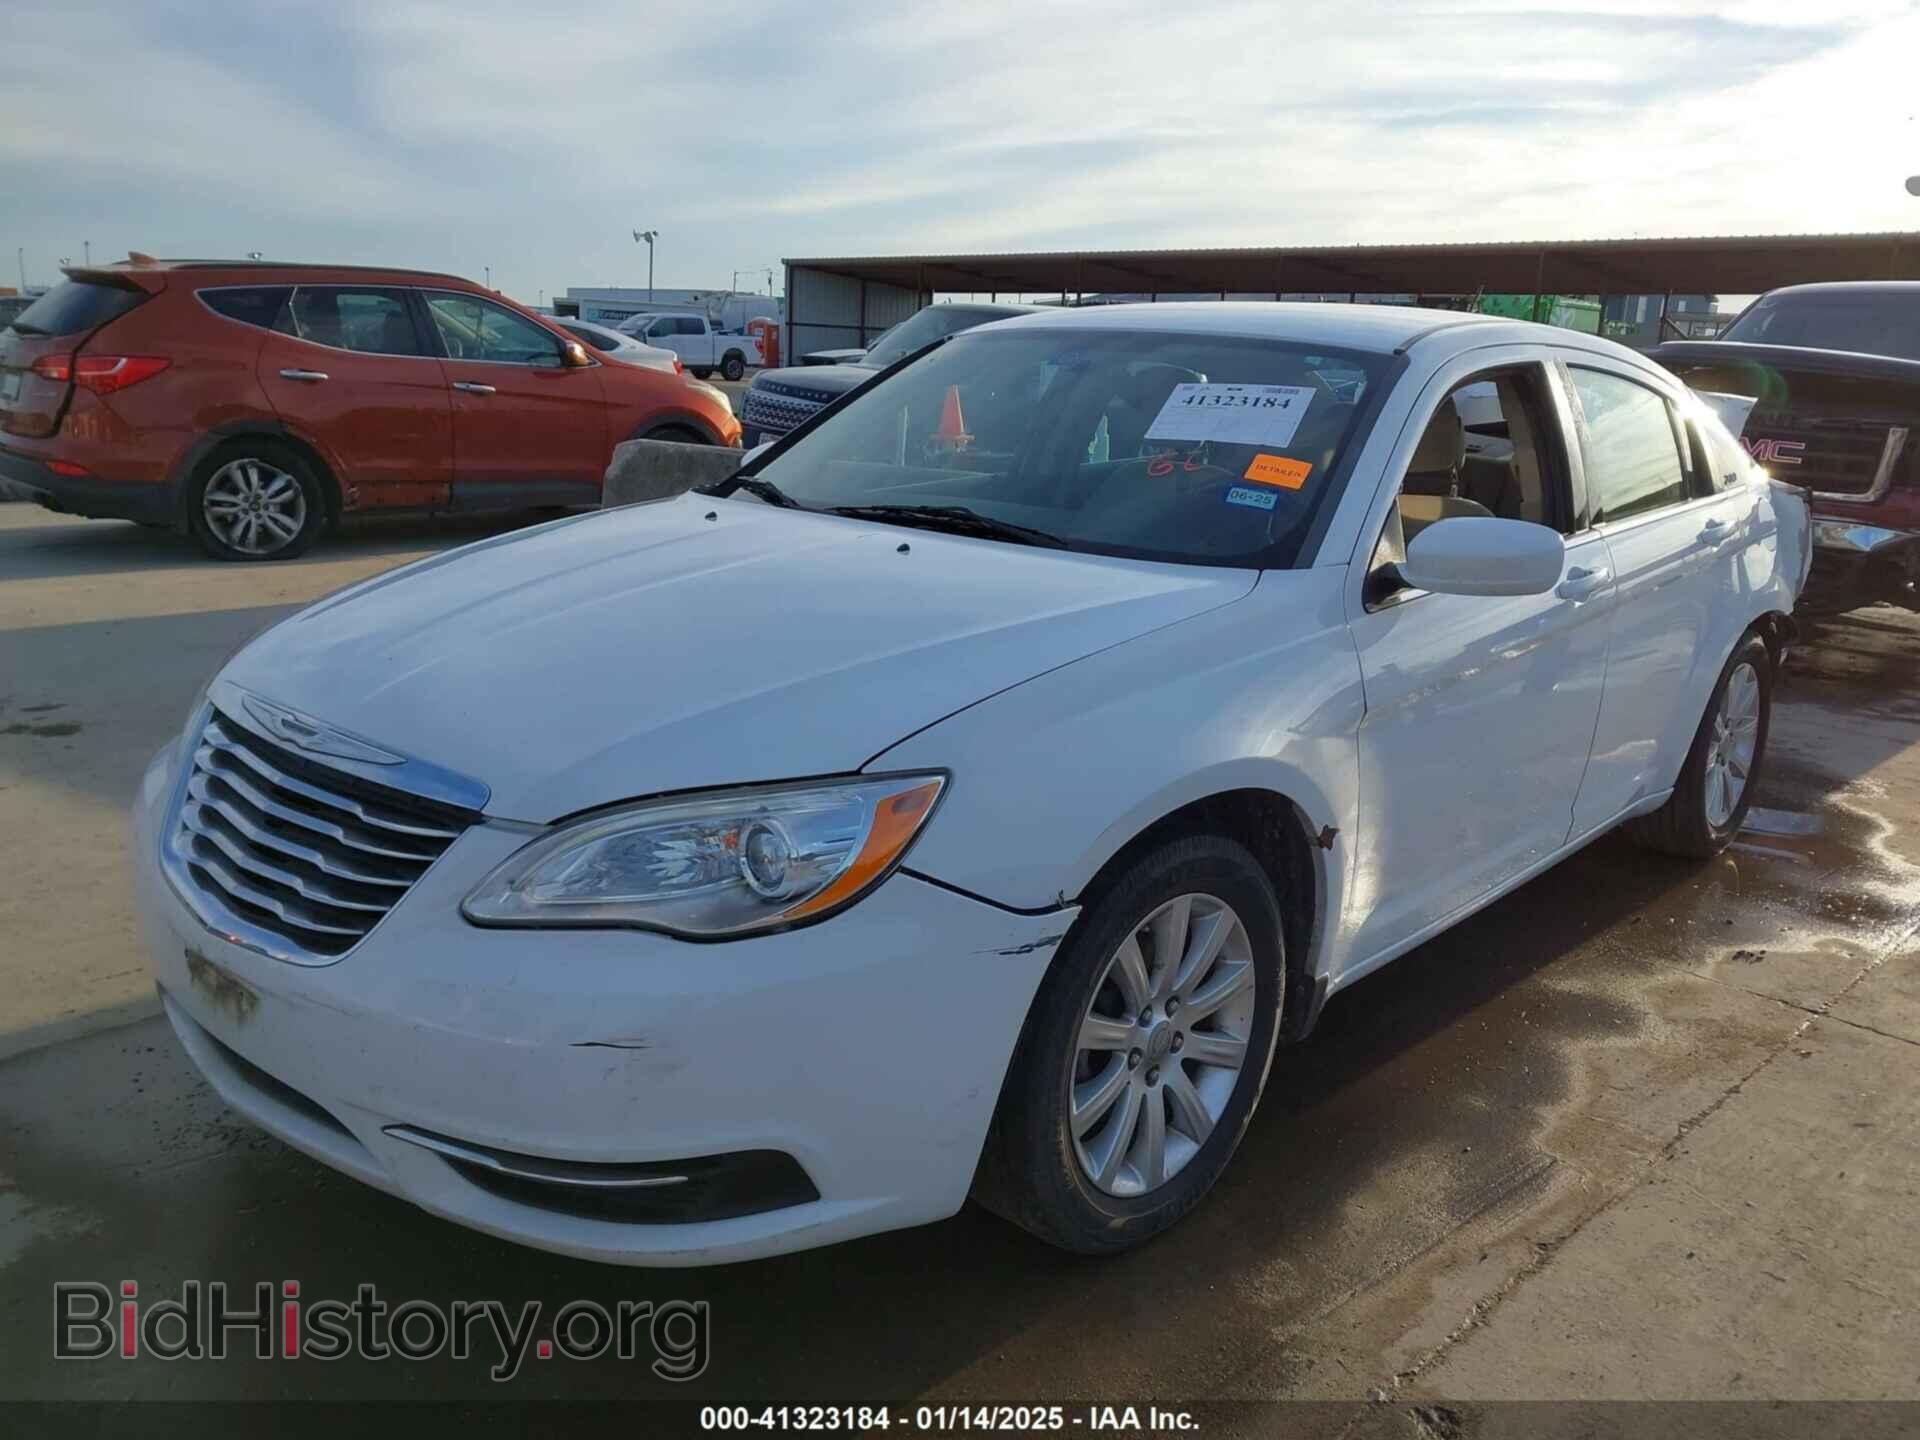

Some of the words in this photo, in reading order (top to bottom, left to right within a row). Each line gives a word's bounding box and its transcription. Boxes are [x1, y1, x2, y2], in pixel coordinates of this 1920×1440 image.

[1182, 395, 1290, 409] 41323184
[1738, 436, 1806, 464] MC
[1230, 489, 1272, 505] 06-25
